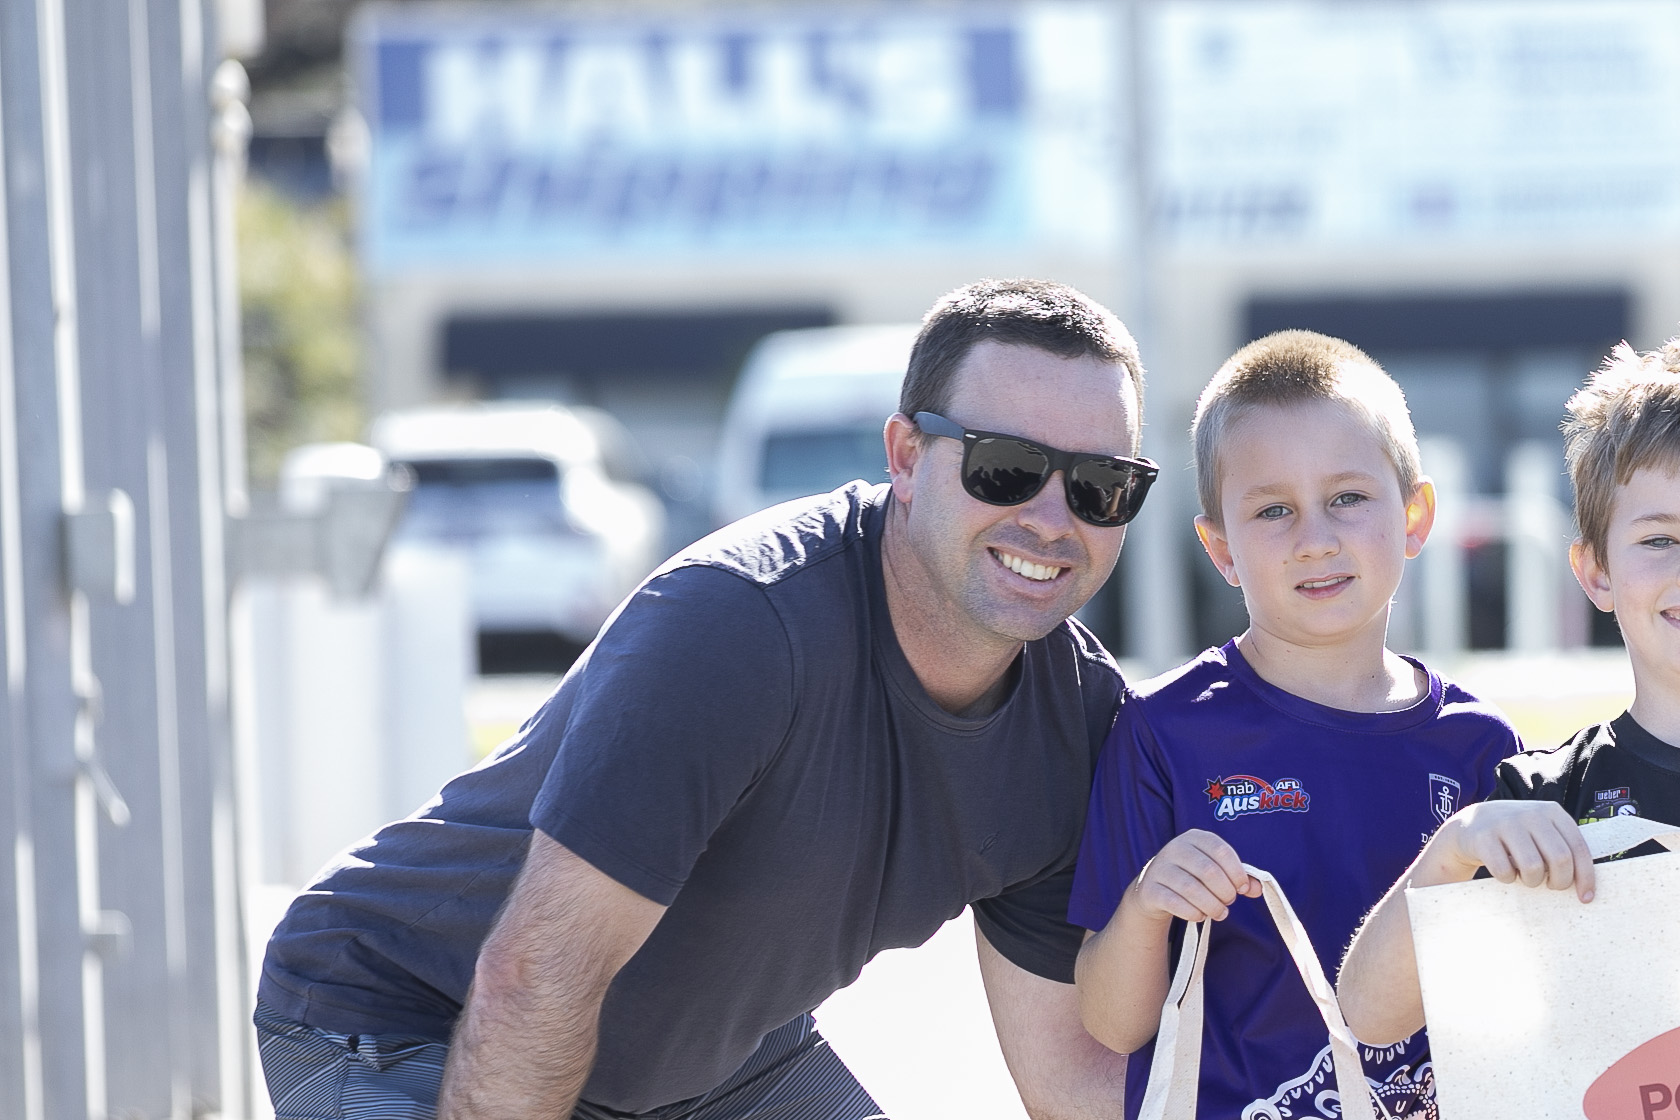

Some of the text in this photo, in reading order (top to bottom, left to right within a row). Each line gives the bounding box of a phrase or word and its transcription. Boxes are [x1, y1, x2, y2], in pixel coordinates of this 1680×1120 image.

[1227, 781, 1255, 796] nab
[1276, 781, 1300, 791] AFL
[1597, 789, 1621, 801] weber
